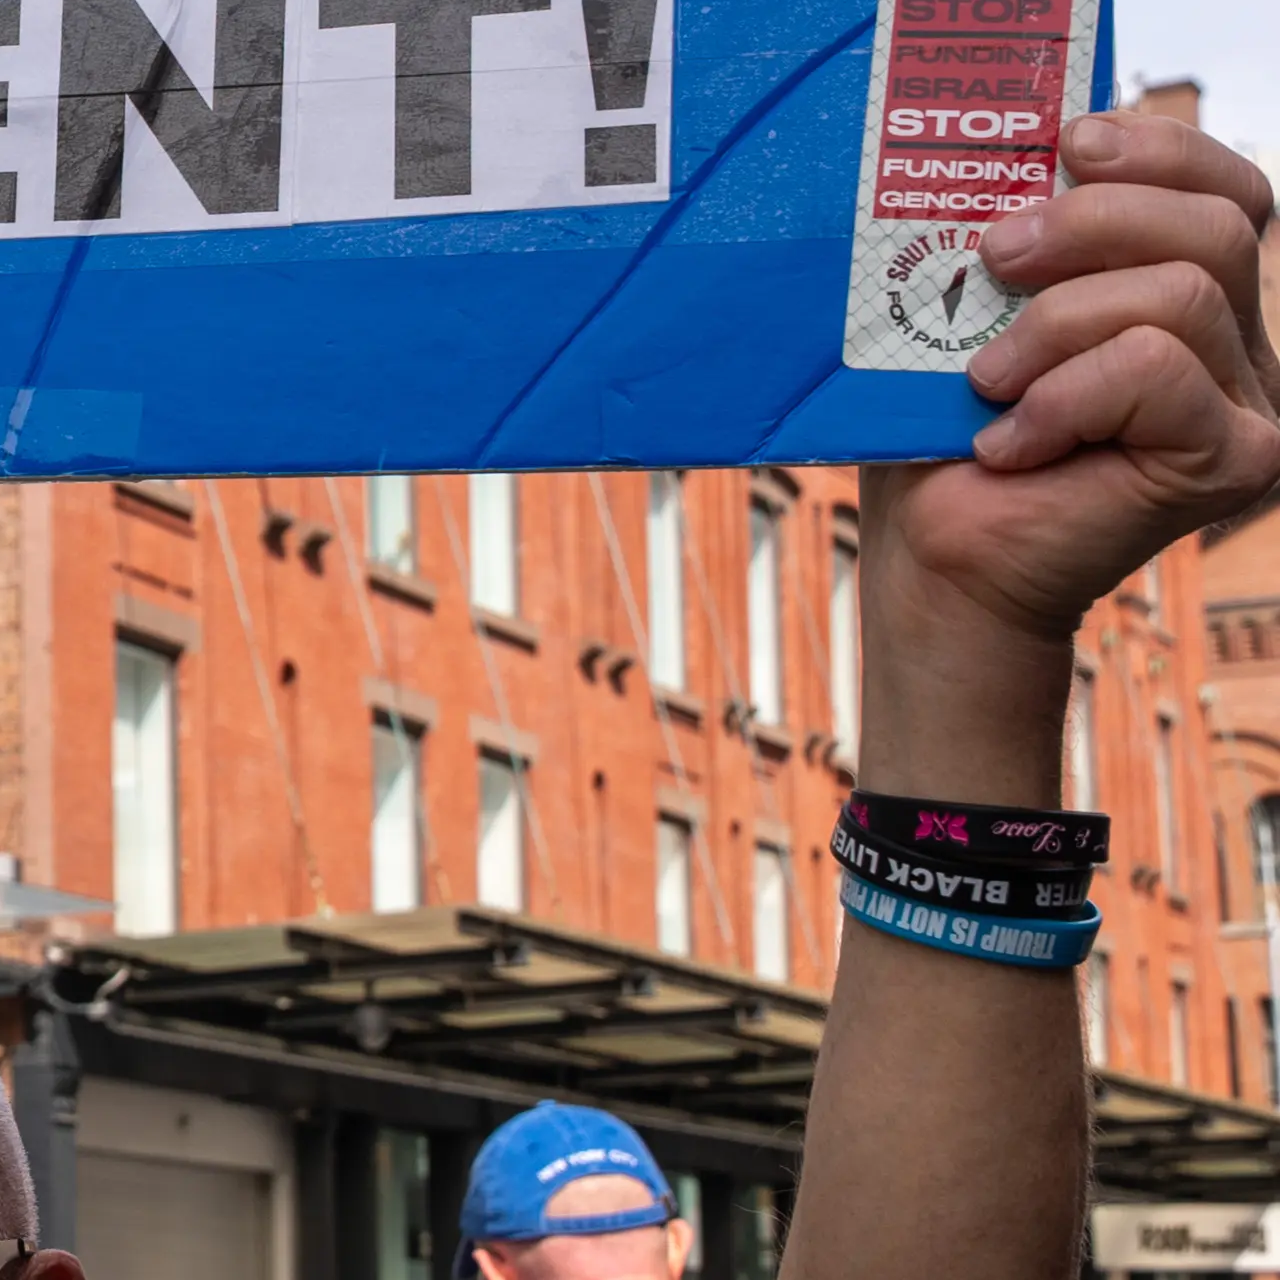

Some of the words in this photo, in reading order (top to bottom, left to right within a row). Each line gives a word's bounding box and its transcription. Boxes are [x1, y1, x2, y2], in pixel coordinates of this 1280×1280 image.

[895, 45, 1059, 65] FUNDING
[892, 77, 1048, 101] ISRAEL
[887, 108, 1041, 139] STOP
[882, 158, 1048, 182] FUNDING
[887, 236, 933, 283] SHUT
[939, 229, 958, 251] IT
[887, 291, 914, 335] FOR
[911, 291, 1022, 352] PALESTINE
[886, 859, 1010, 905] BLACK
[1036, 882, 1085, 908] TTER
[897, 902, 949, 939] NOT
[949, 916, 978, 948] IS
[980, 924, 1057, 960] TRUMP
